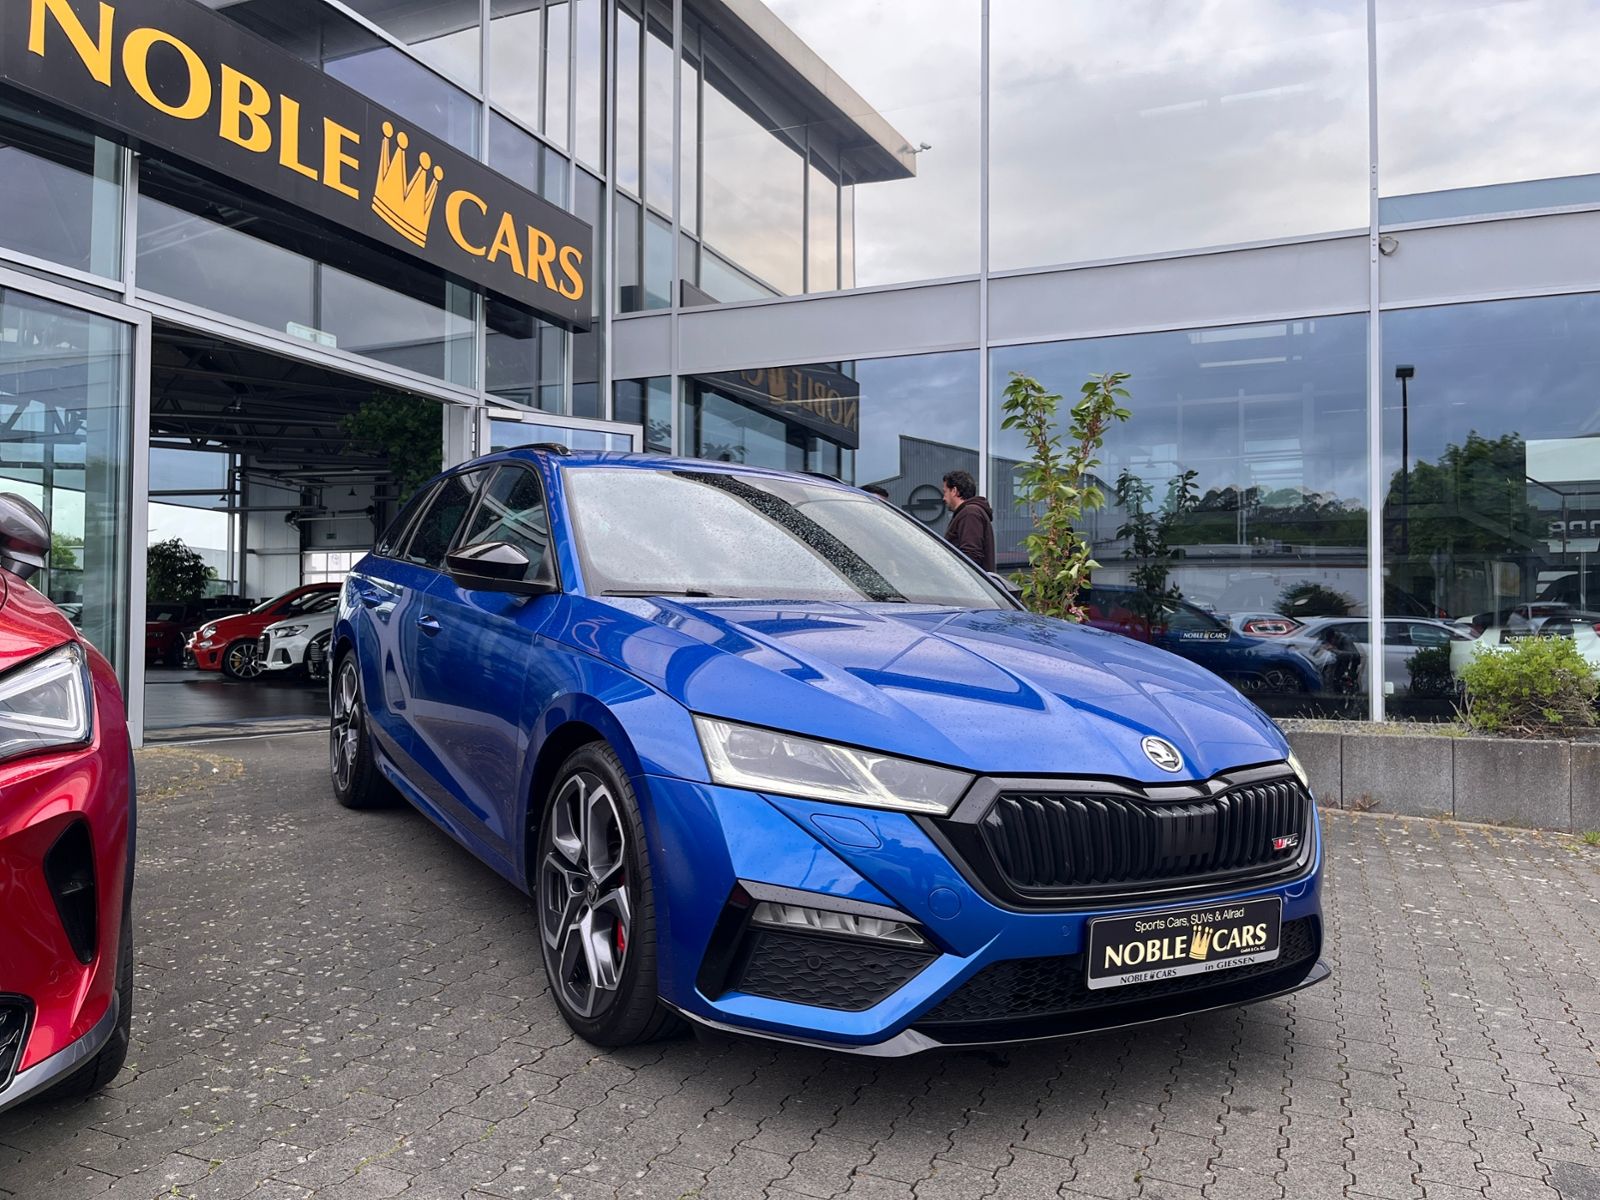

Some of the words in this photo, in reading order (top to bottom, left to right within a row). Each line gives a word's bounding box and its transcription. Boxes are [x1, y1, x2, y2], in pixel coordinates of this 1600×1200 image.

[28, 0, 360, 200] NOBLE
[444, 189, 584, 300] CARS
[1134, 920, 1165, 933] Sports
[1167, 917, 1189, 928] Cars,
[1190, 913, 1213, 925] SUVs
[1215, 911, 1221, 921] &
[1222, 908, 1245, 920] Allrad
[1104, 936, 1187, 969] NOBLE
[1212, 923, 1267, 952] CARS
[1217, 957, 1255, 969] GIESSEN
[1120, 973, 1148, 985] NOBLE
[1156, 969, 1177, 979] CARS
